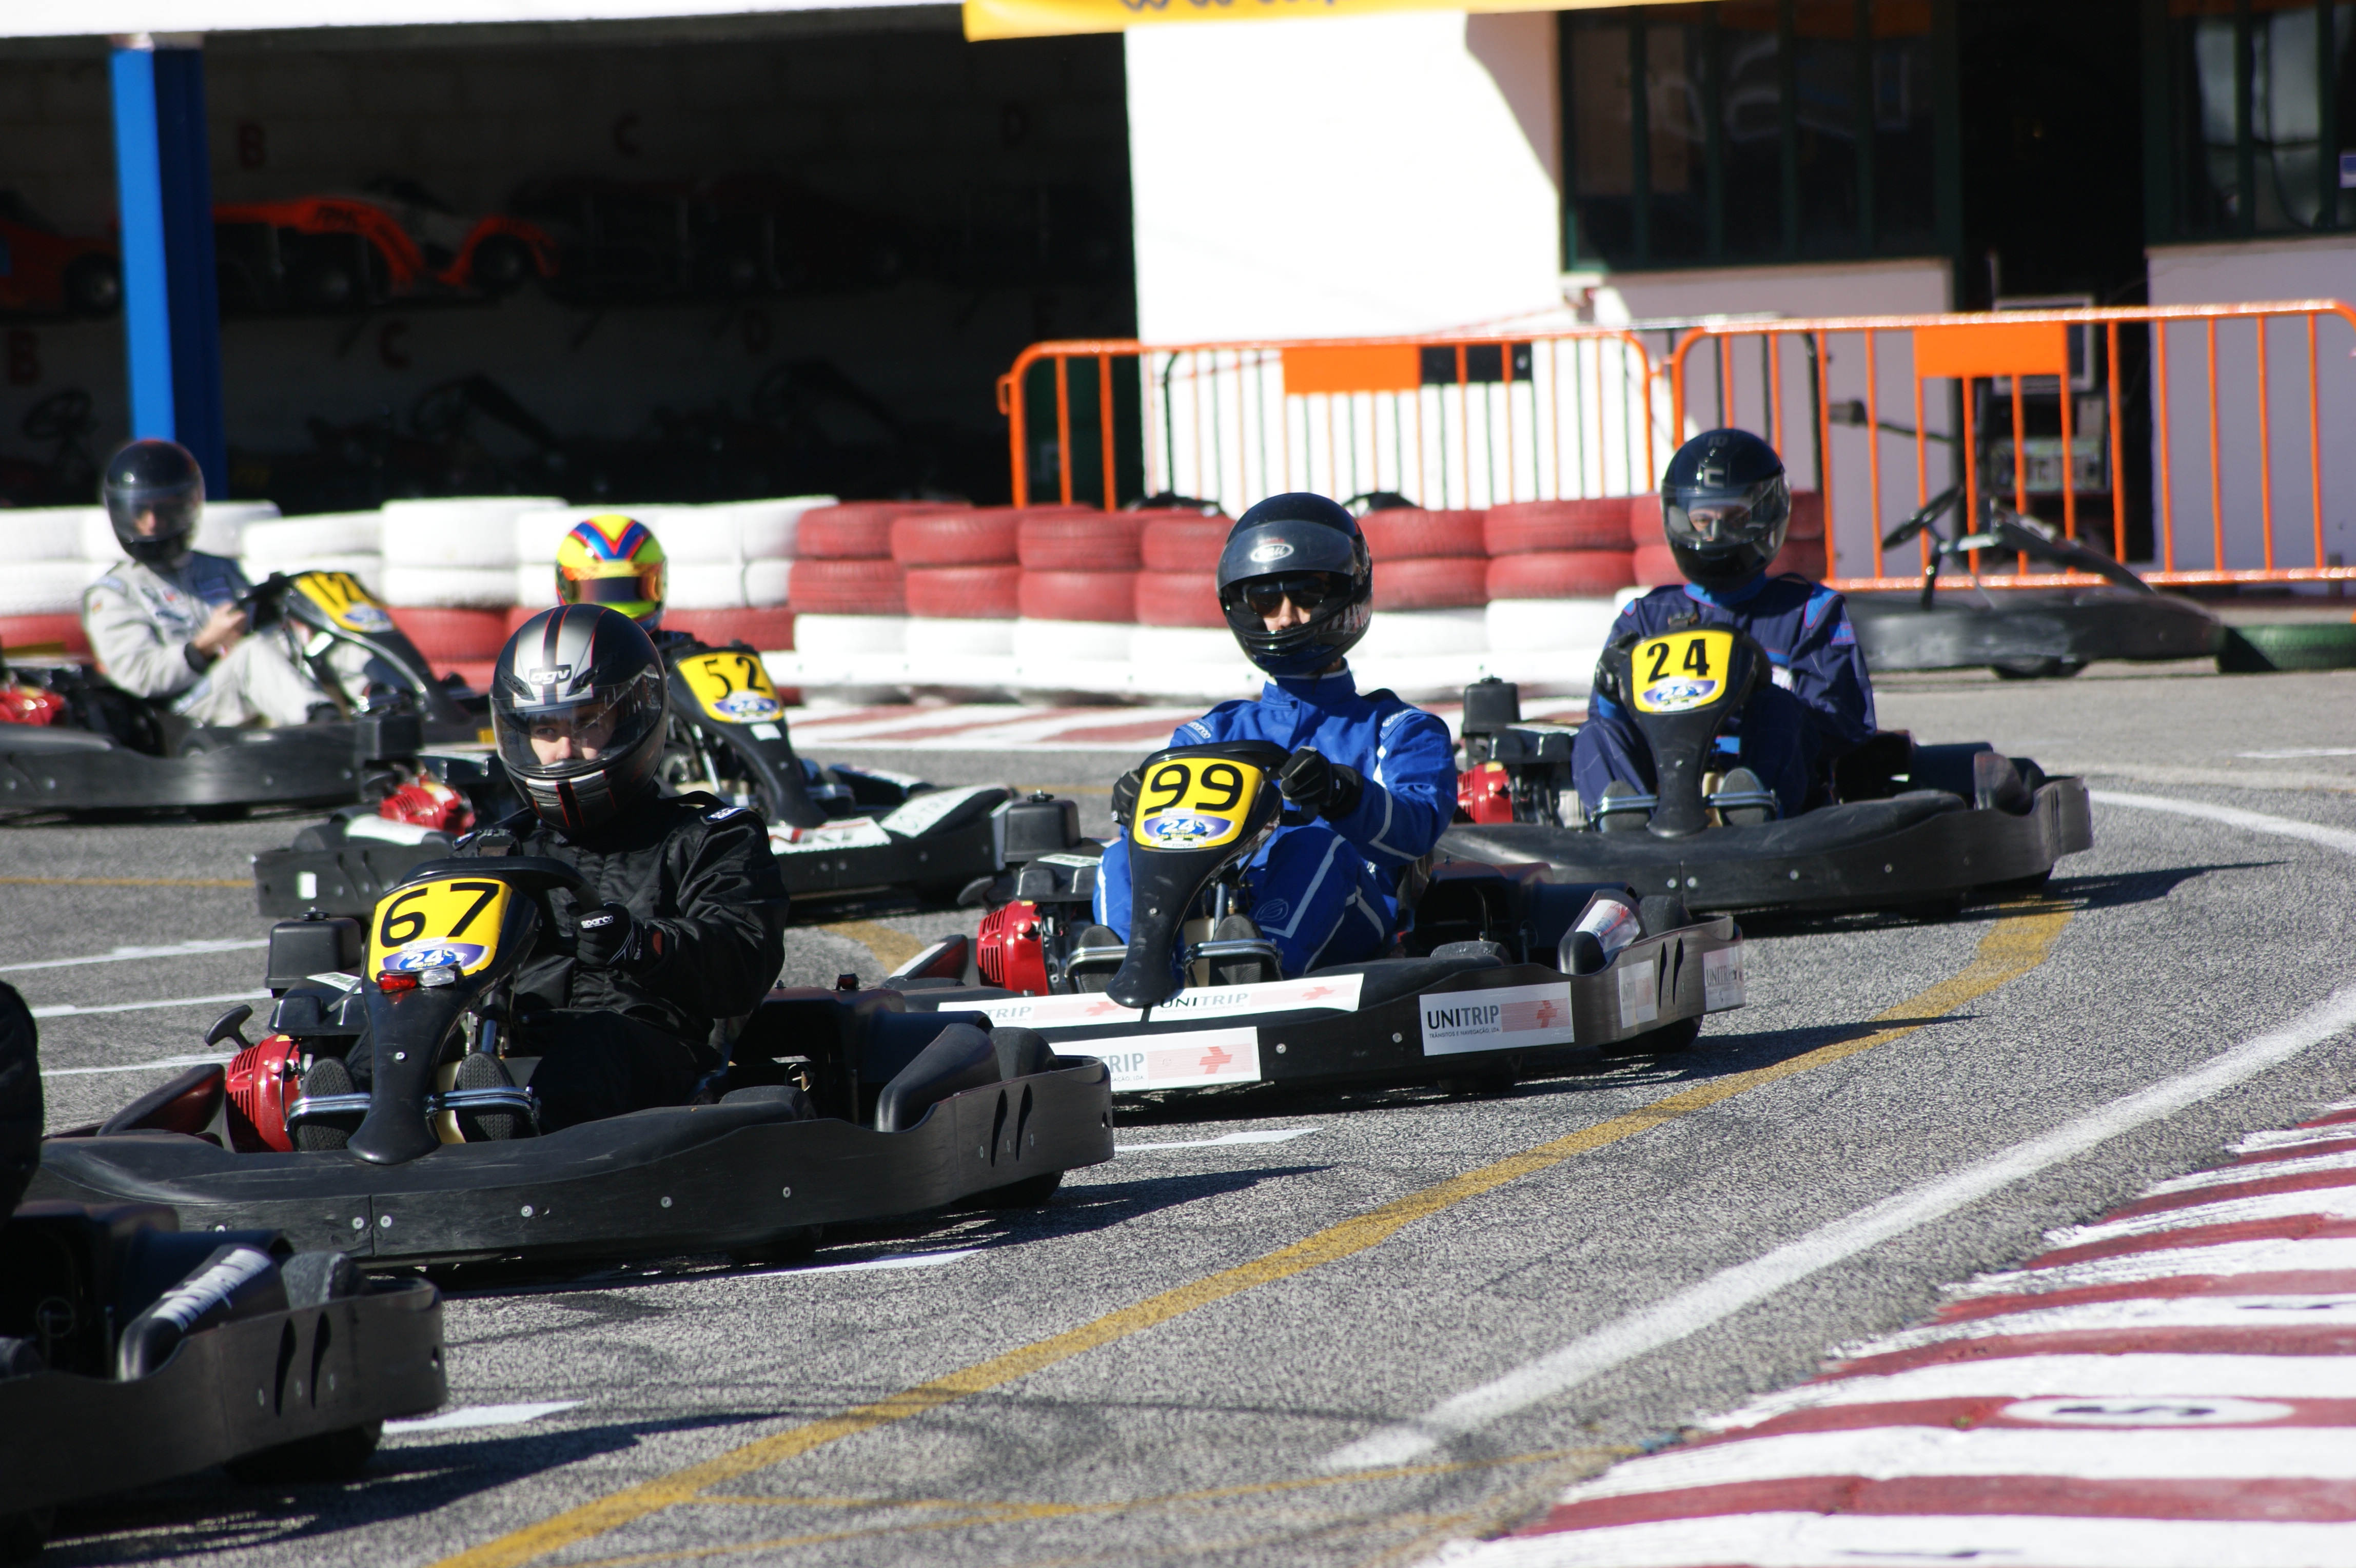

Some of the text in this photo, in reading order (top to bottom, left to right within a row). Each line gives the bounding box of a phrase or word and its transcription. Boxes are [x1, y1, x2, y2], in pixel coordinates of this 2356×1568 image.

[237, 122, 265, 169] B
[7, 329, 41, 385] B
[379, 321, 410, 368] C
[530, 669, 570, 685] agv
[702, 656, 768, 699] 52
[1646, 638, 1710, 683] 24
[1144, 763, 1244, 815] 99
[1162, 819, 1196, 833] 24
[380, 881, 500, 948] 67
[406, 949, 444, 969] 24
[1160, 993, 1248, 1008] UNITRIP
[1427, 1005, 1499, 1030] UNITRIP
